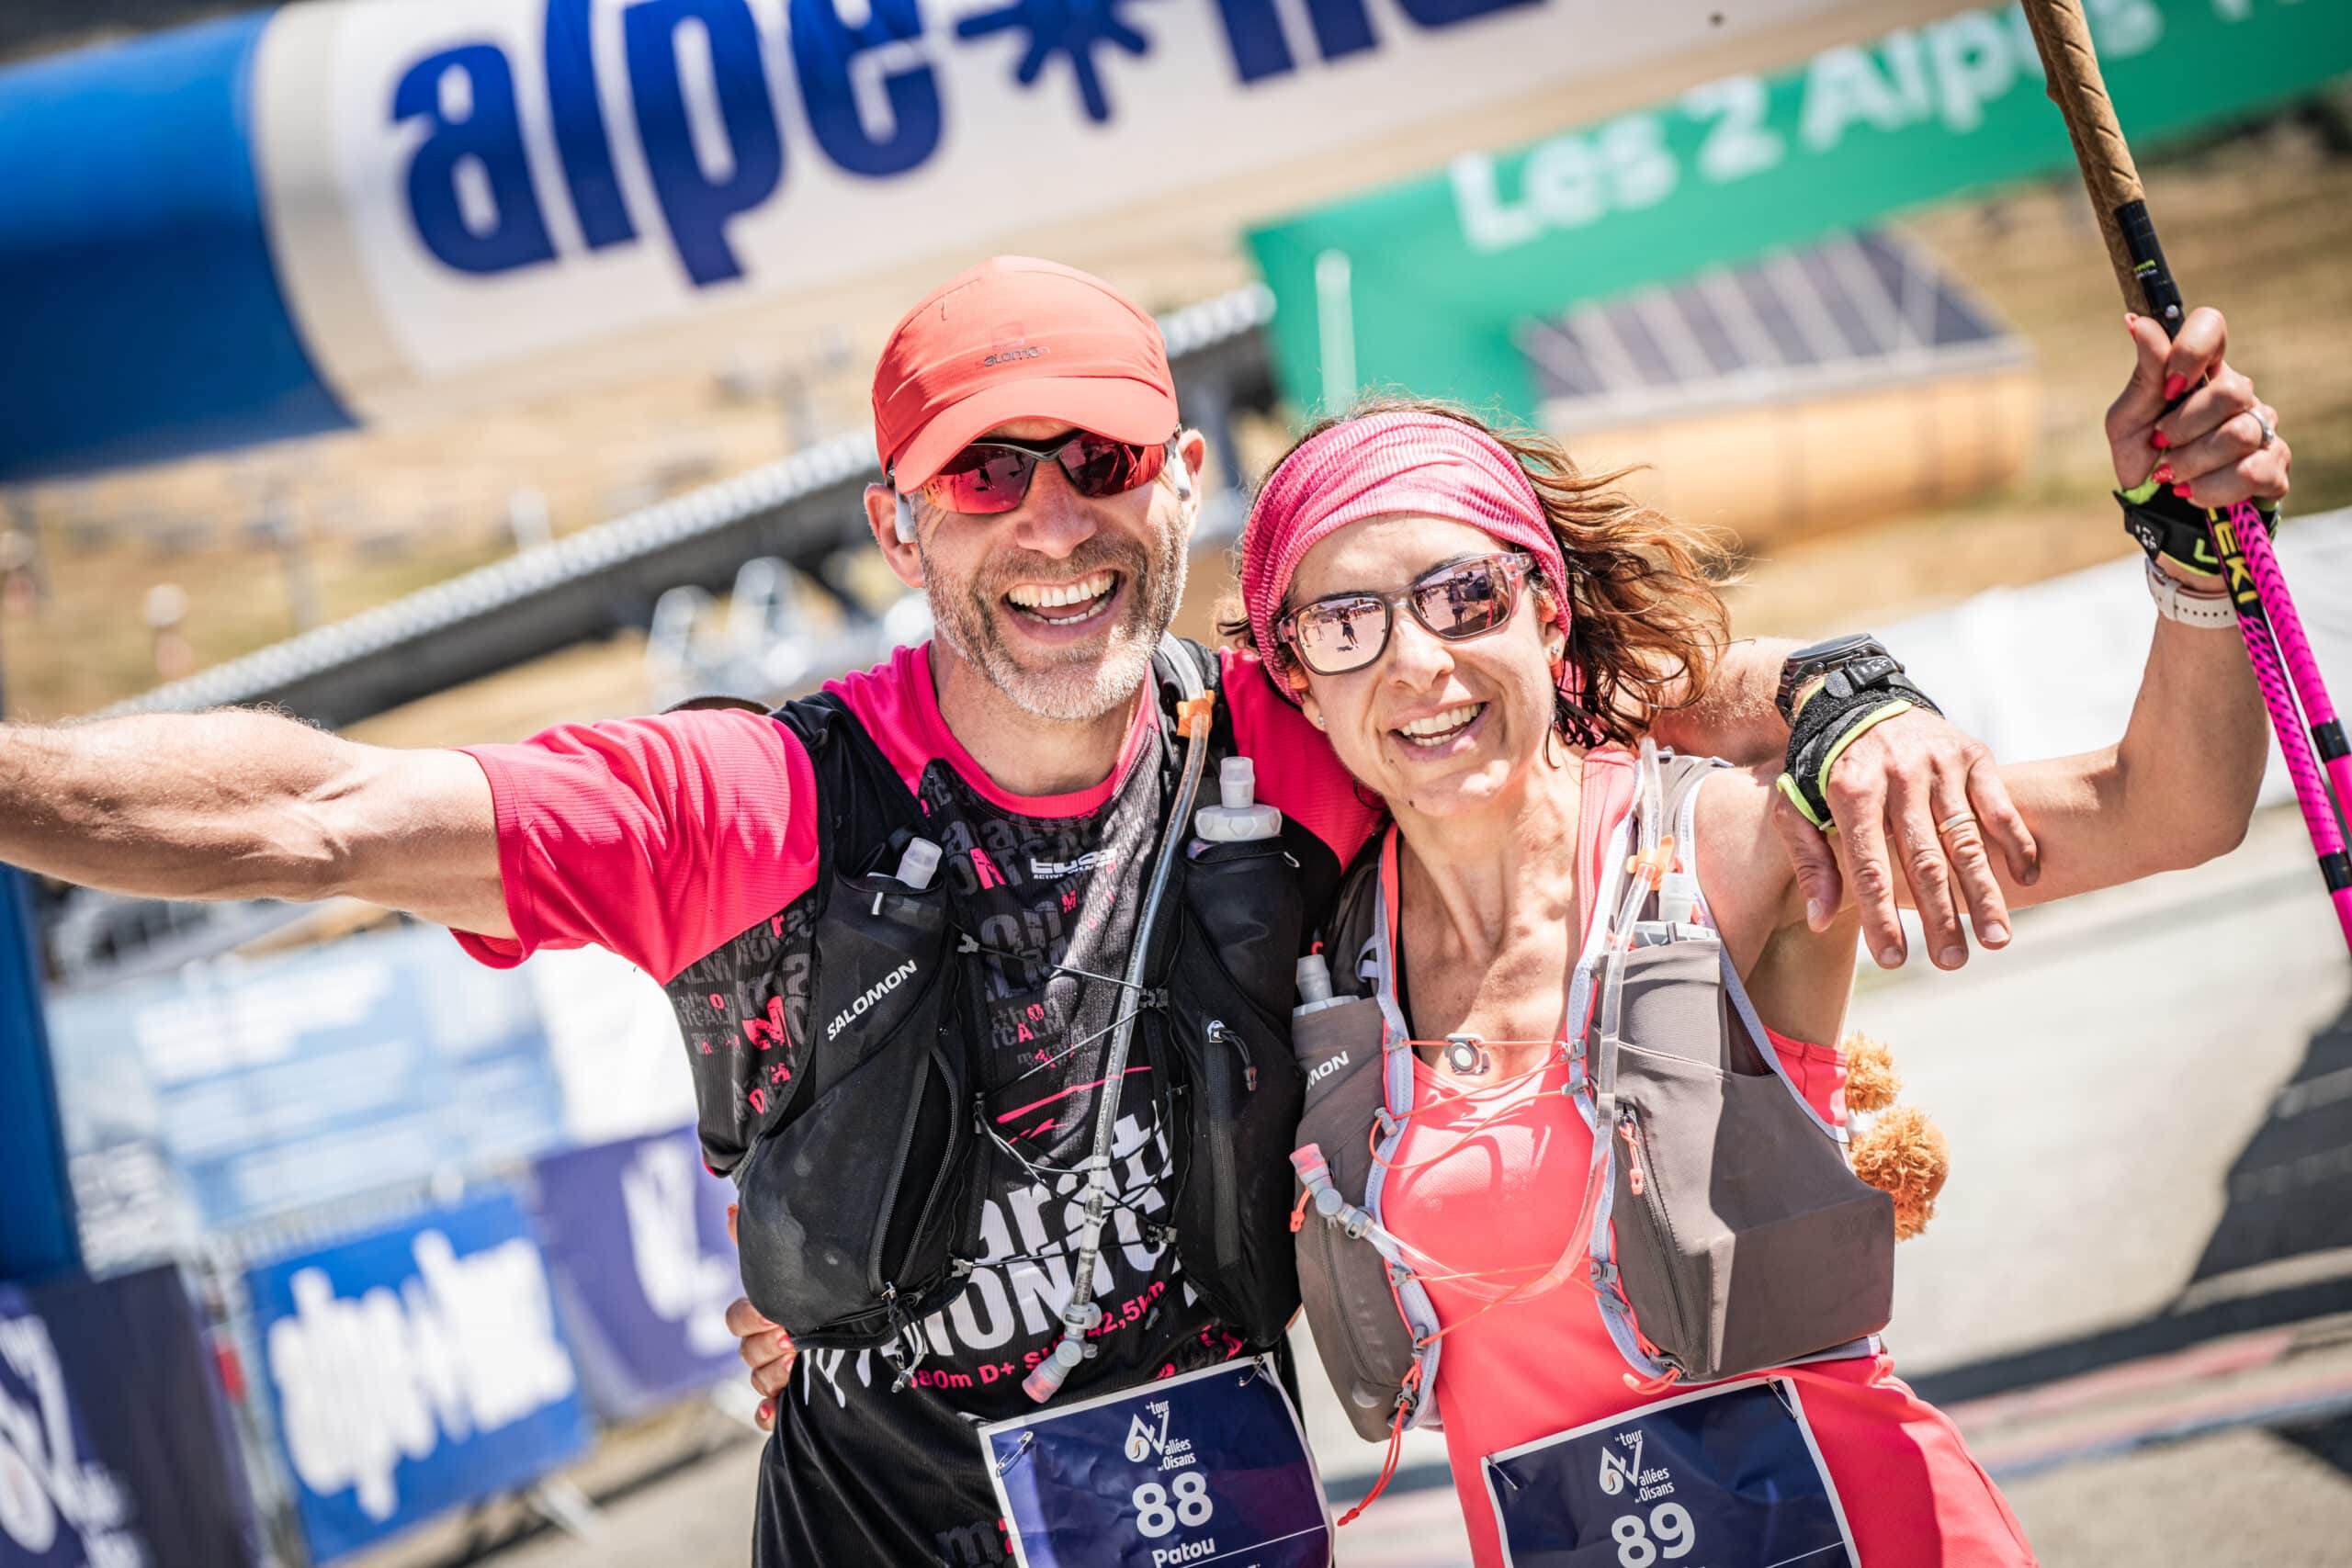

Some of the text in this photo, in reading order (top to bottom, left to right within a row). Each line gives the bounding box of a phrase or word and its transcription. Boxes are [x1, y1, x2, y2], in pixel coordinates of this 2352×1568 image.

[1448, 110, 1679, 254] Les
[1683, 73, 1786, 182] 2
[827, 959, 918, 1042] SALOMON
[1306, 1050, 1350, 1091] MON
[978, 1360, 1016, 1386] D+
[1087, 1281, 1167, 1337] 2,5km
[1620, 1429, 1643, 1446] tour
[1132, 1471, 1214, 1539] 88
[1611, 1502, 1696, 1568] 89
[1152, 1538, 1216, 1568] Patou
